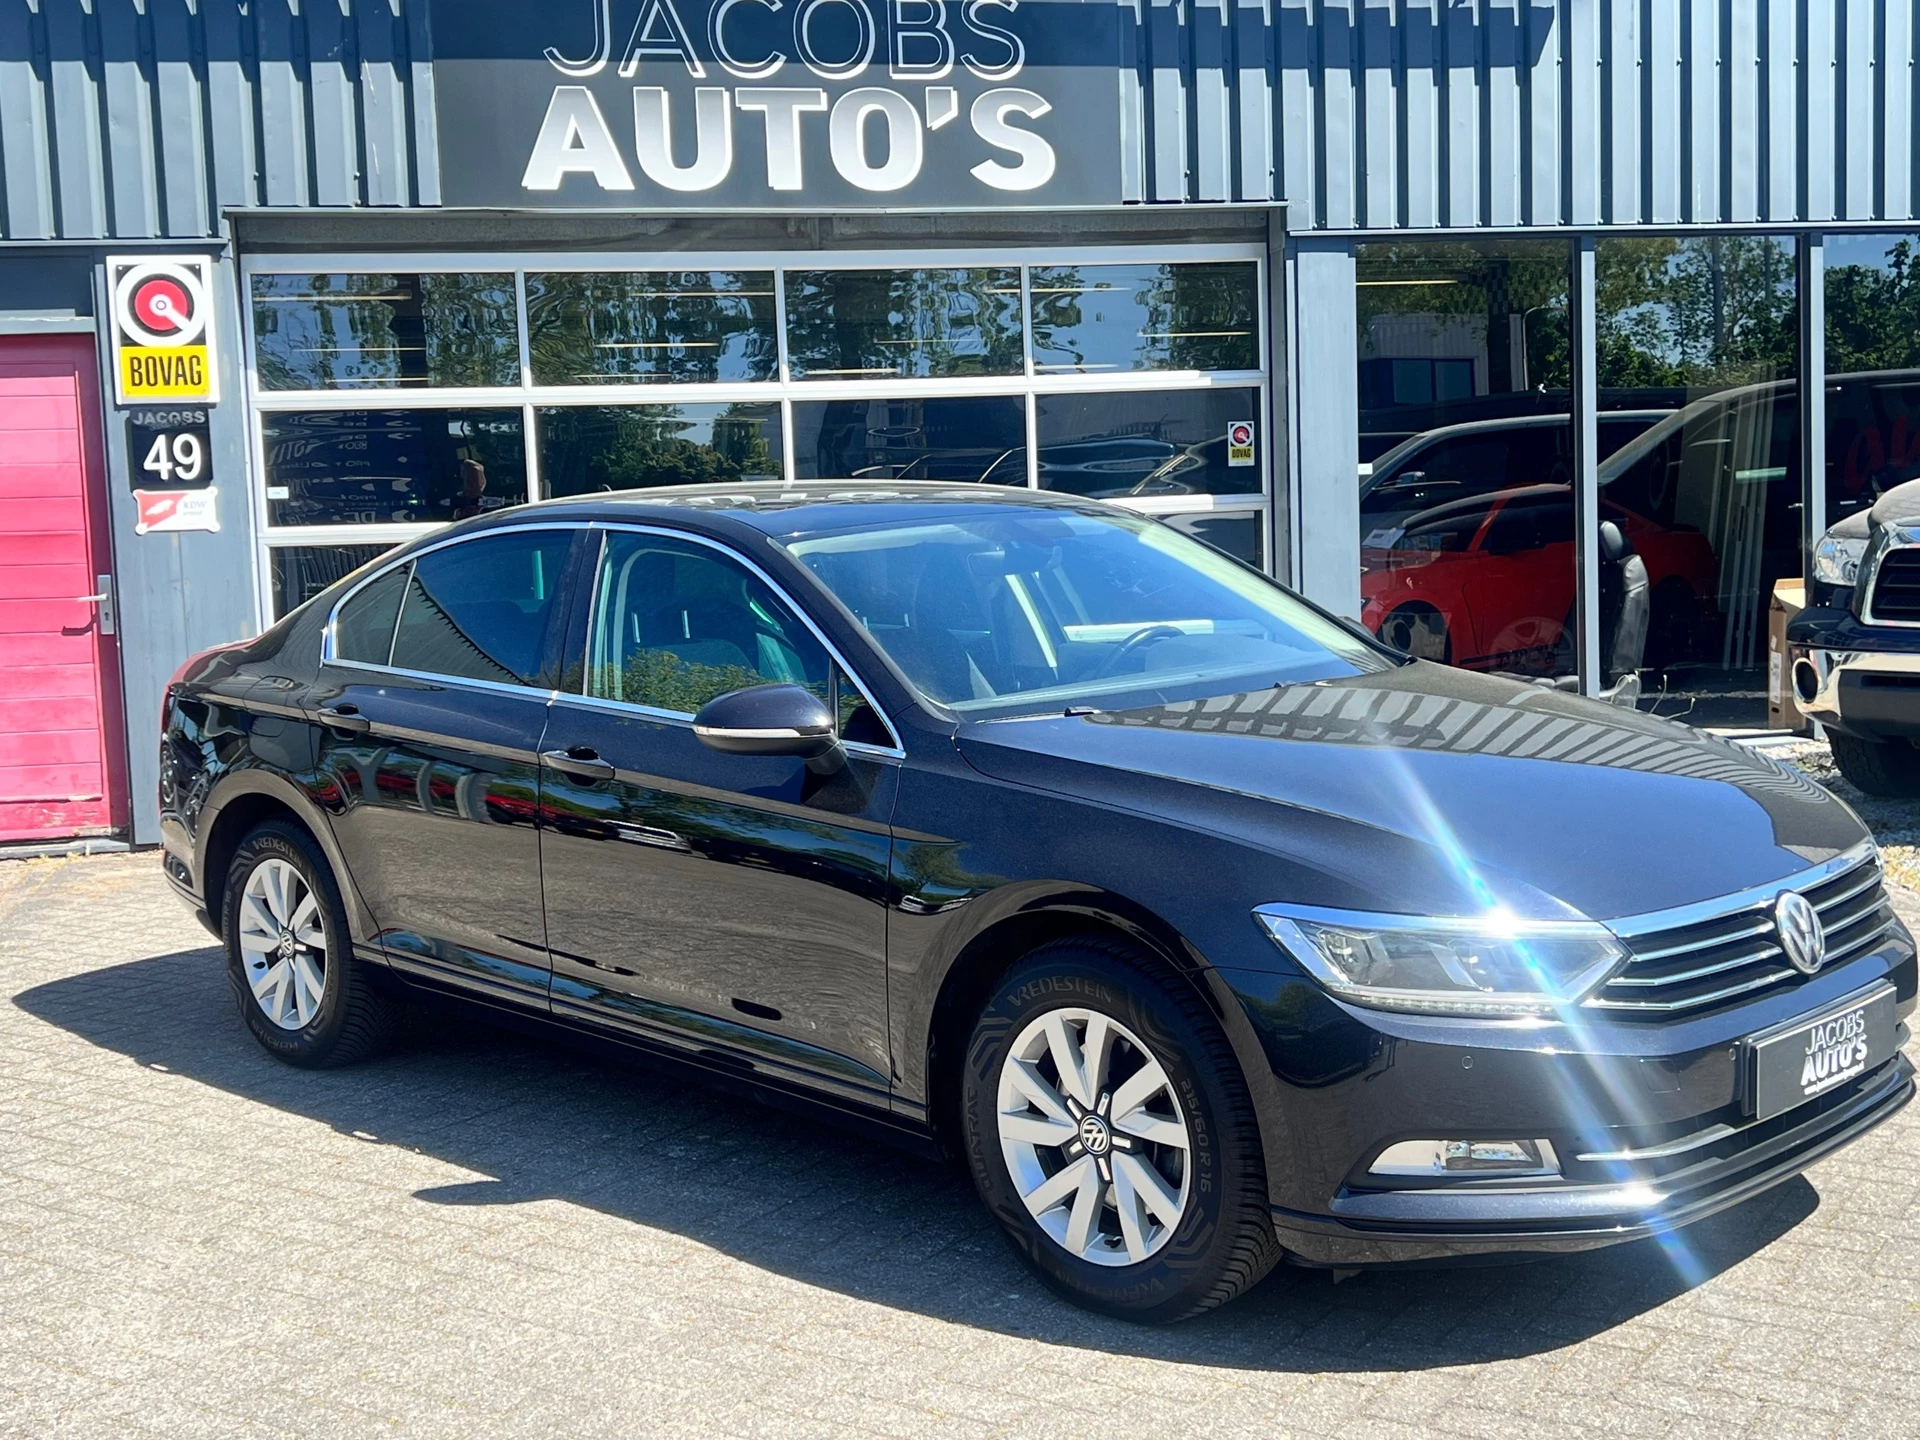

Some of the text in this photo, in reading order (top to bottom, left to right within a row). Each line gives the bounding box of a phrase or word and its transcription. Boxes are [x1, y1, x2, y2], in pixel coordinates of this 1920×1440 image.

[543, 0, 1025, 79] JACOBS
[521, 86, 1056, 191] AUTO'S
[129, 355, 202, 387] BOVAG
[133, 411, 205, 425] JACOBS
[143, 433, 201, 480] 49
[1232, 448, 1251, 458] BOVAG
[183, 500, 208, 508] RDW
[1007, 975, 1112, 1007] VREDESTEIN
[1805, 1009, 1864, 1055] JACOBS
[1800, 1034, 1867, 1086] AUTO'S
[1181, 1079, 1211, 1193] 215/60 R 16
